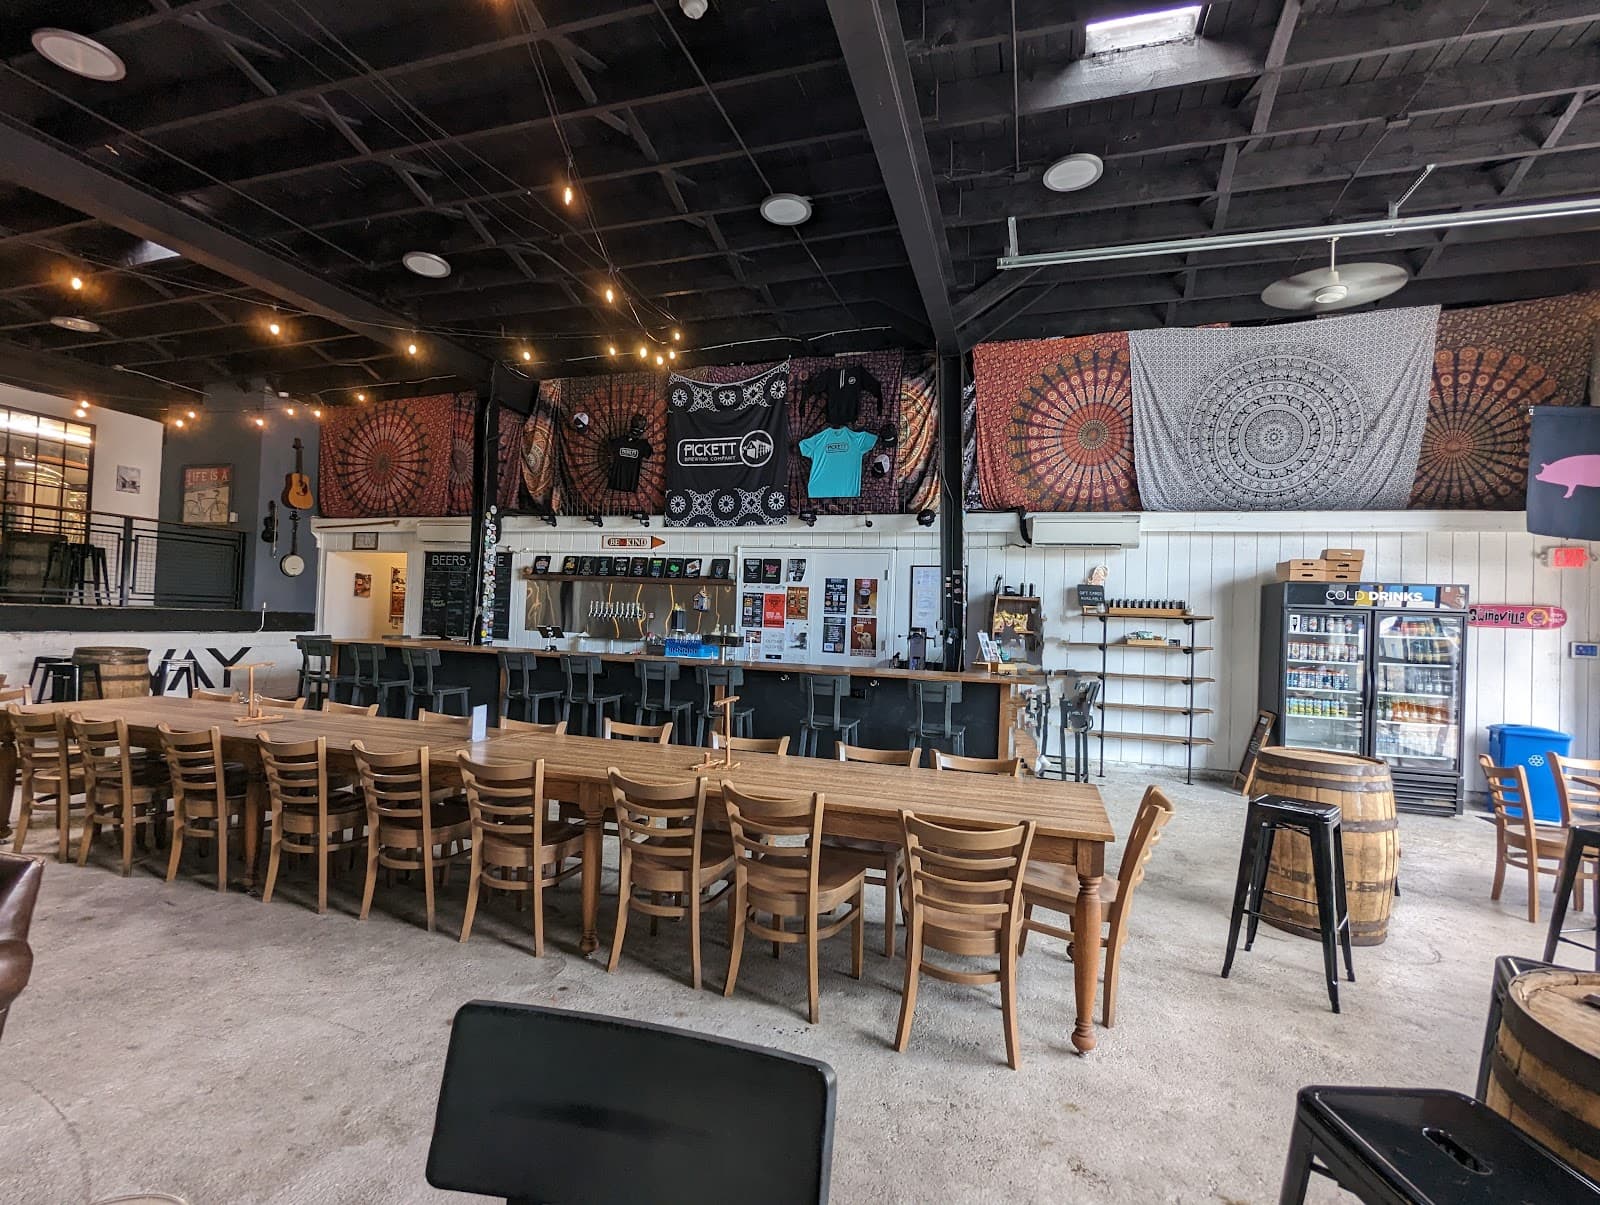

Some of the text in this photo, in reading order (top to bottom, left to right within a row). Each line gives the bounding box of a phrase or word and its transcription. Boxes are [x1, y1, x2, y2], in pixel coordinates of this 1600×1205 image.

[684, 442, 737, 457] PICKETT
[186, 470, 228, 484] LIFE IS A
[610, 538, 647, 546] BE KIND
[431, 555, 467, 566] BEERS
[1325, 590, 1424, 602] COLD DRINKS
